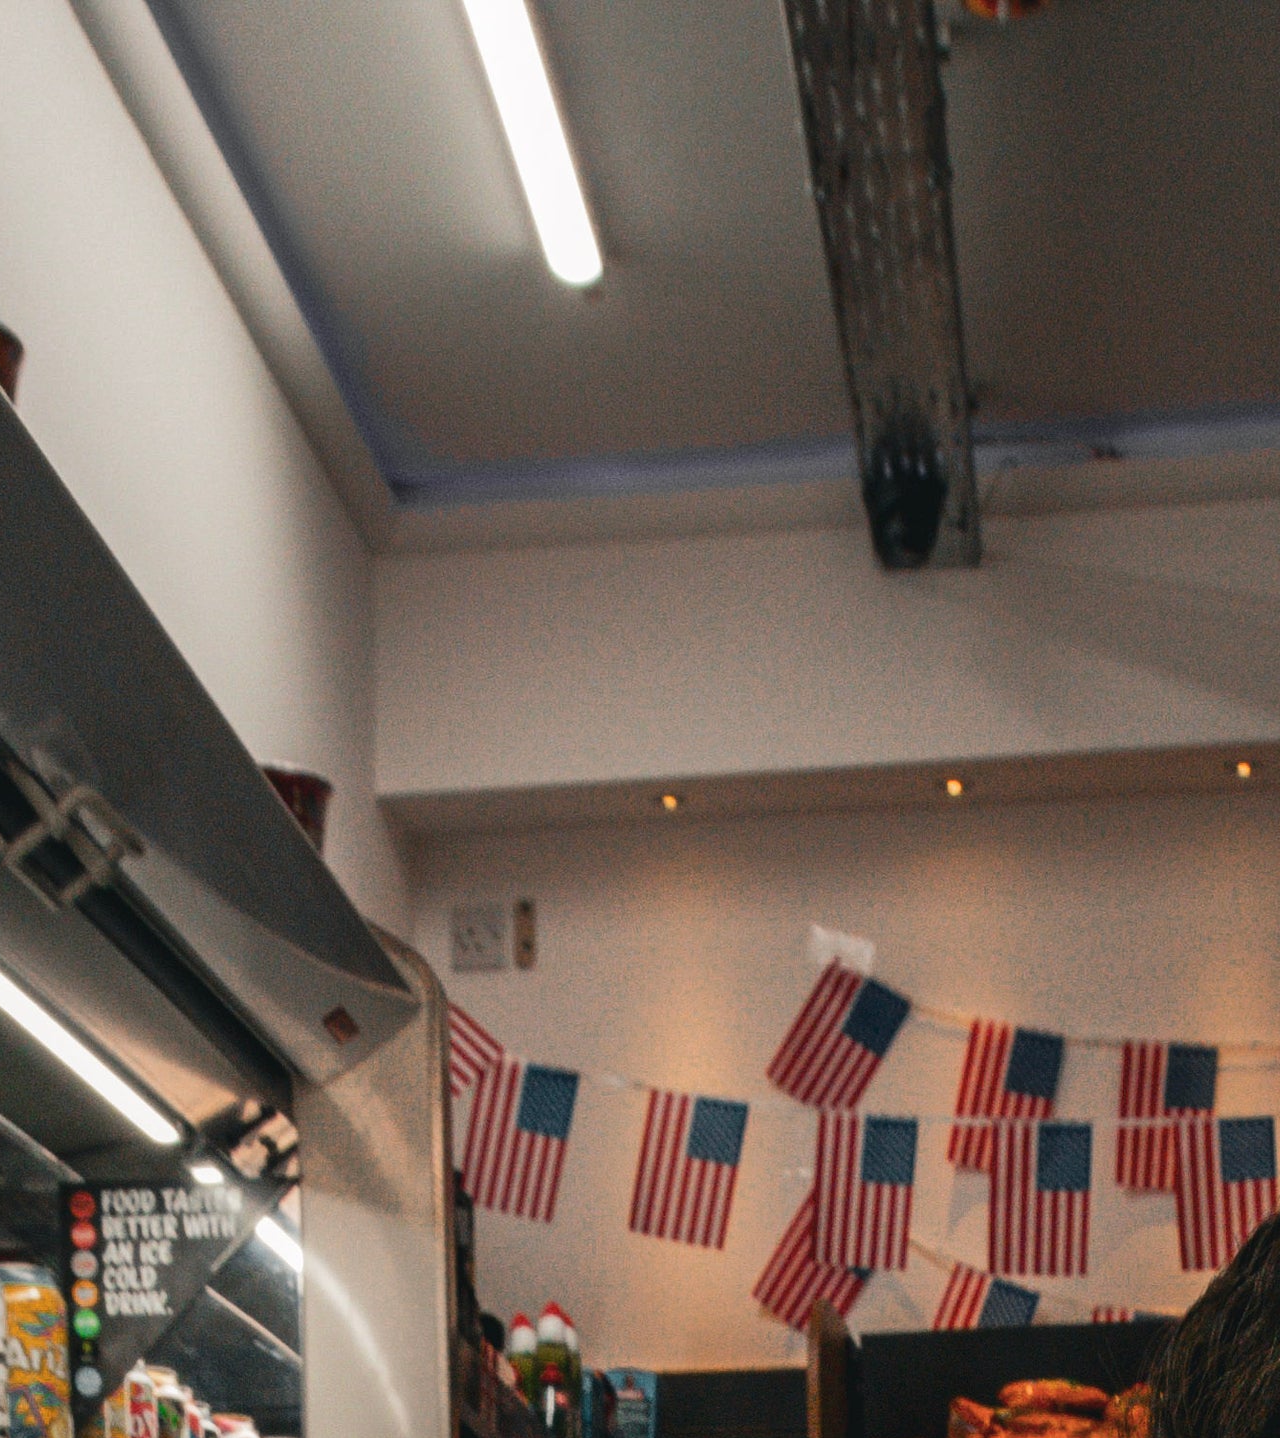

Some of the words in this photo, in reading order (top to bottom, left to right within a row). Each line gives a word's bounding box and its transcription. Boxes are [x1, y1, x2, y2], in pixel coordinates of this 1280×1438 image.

[102, 1240, 134, 1265] AN
[139, 1240, 173, 1266] ICE
[103, 1265, 157, 1290] COLD
